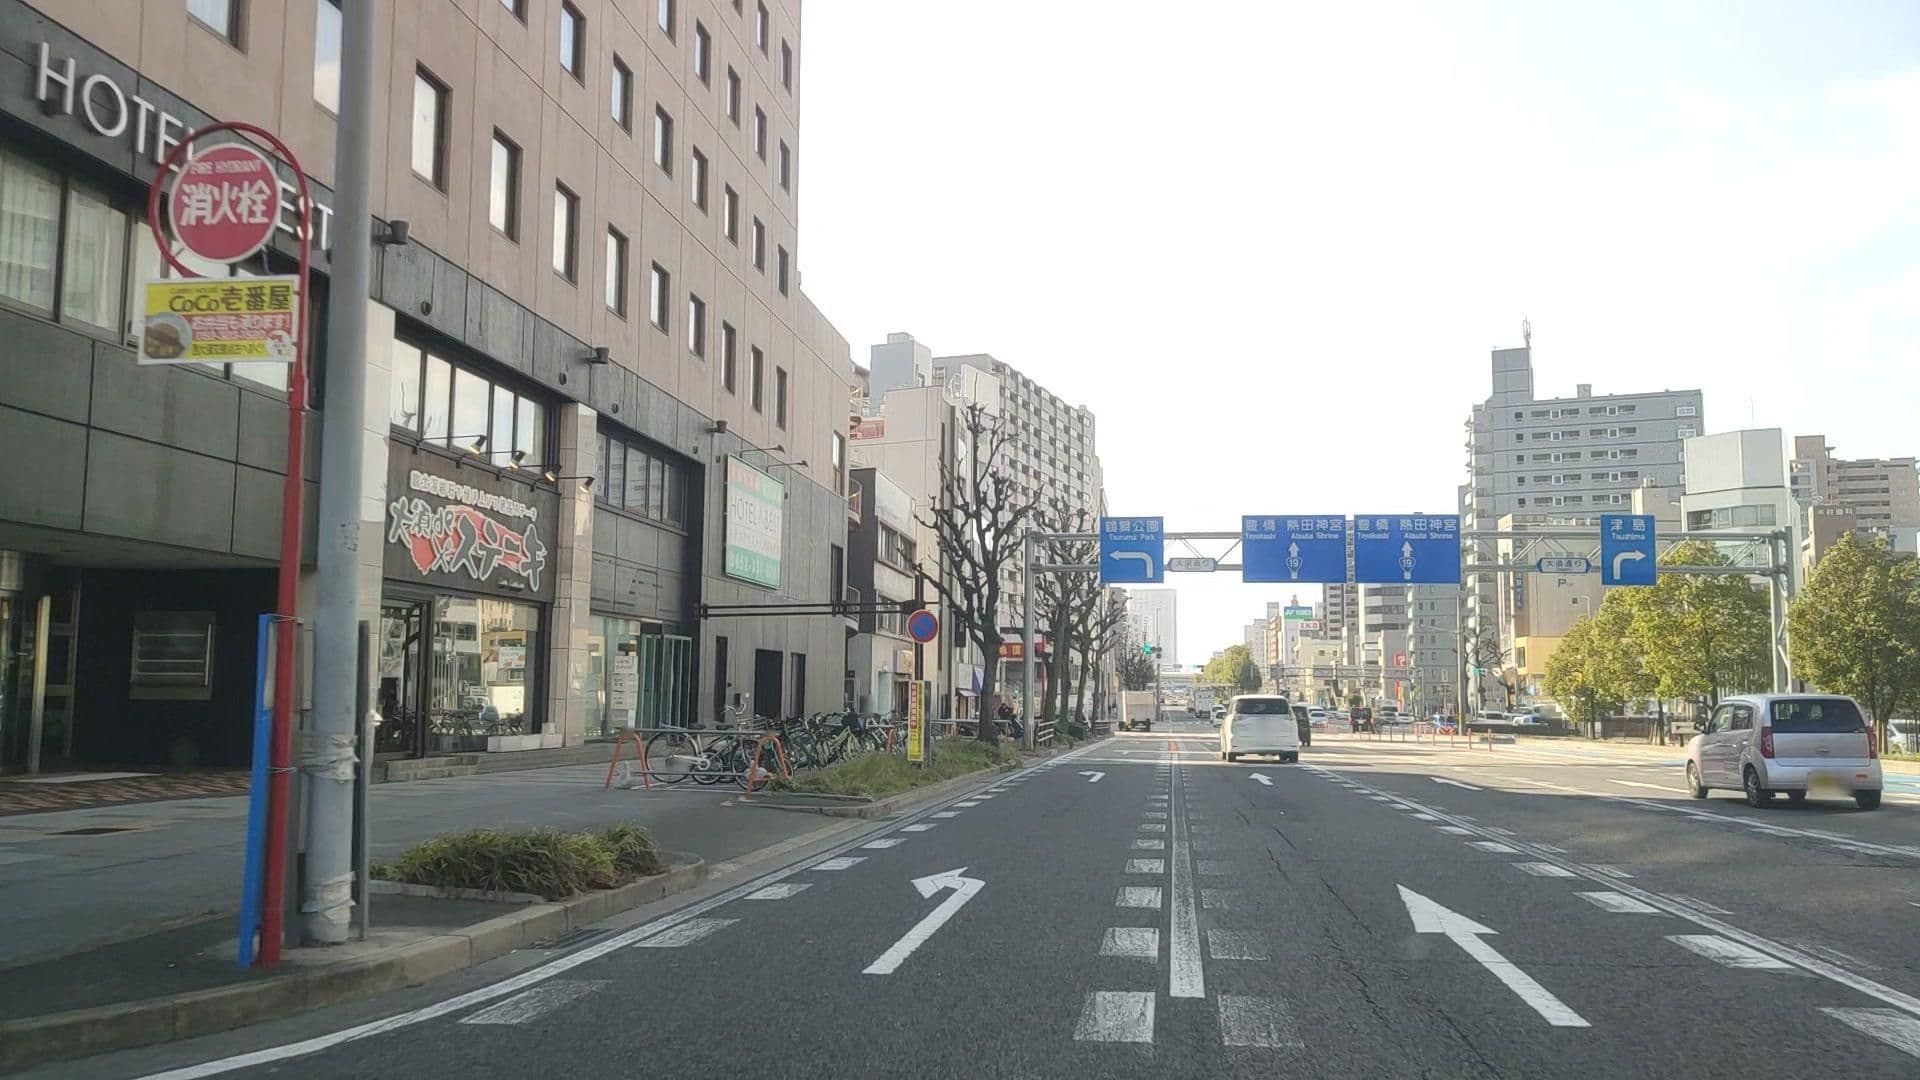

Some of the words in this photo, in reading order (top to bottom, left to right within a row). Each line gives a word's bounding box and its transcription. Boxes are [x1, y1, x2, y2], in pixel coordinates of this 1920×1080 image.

[180, 179, 272, 226] 消火栓
[1287, 519, 1342, 531] 熱田神宮
[1400, 519, 1457, 531] 熱田神宮
[1610, 518, 1646, 531] 津島
[1289, 558, 1299, 568] 19
[1402, 558, 1413, 568] 19
